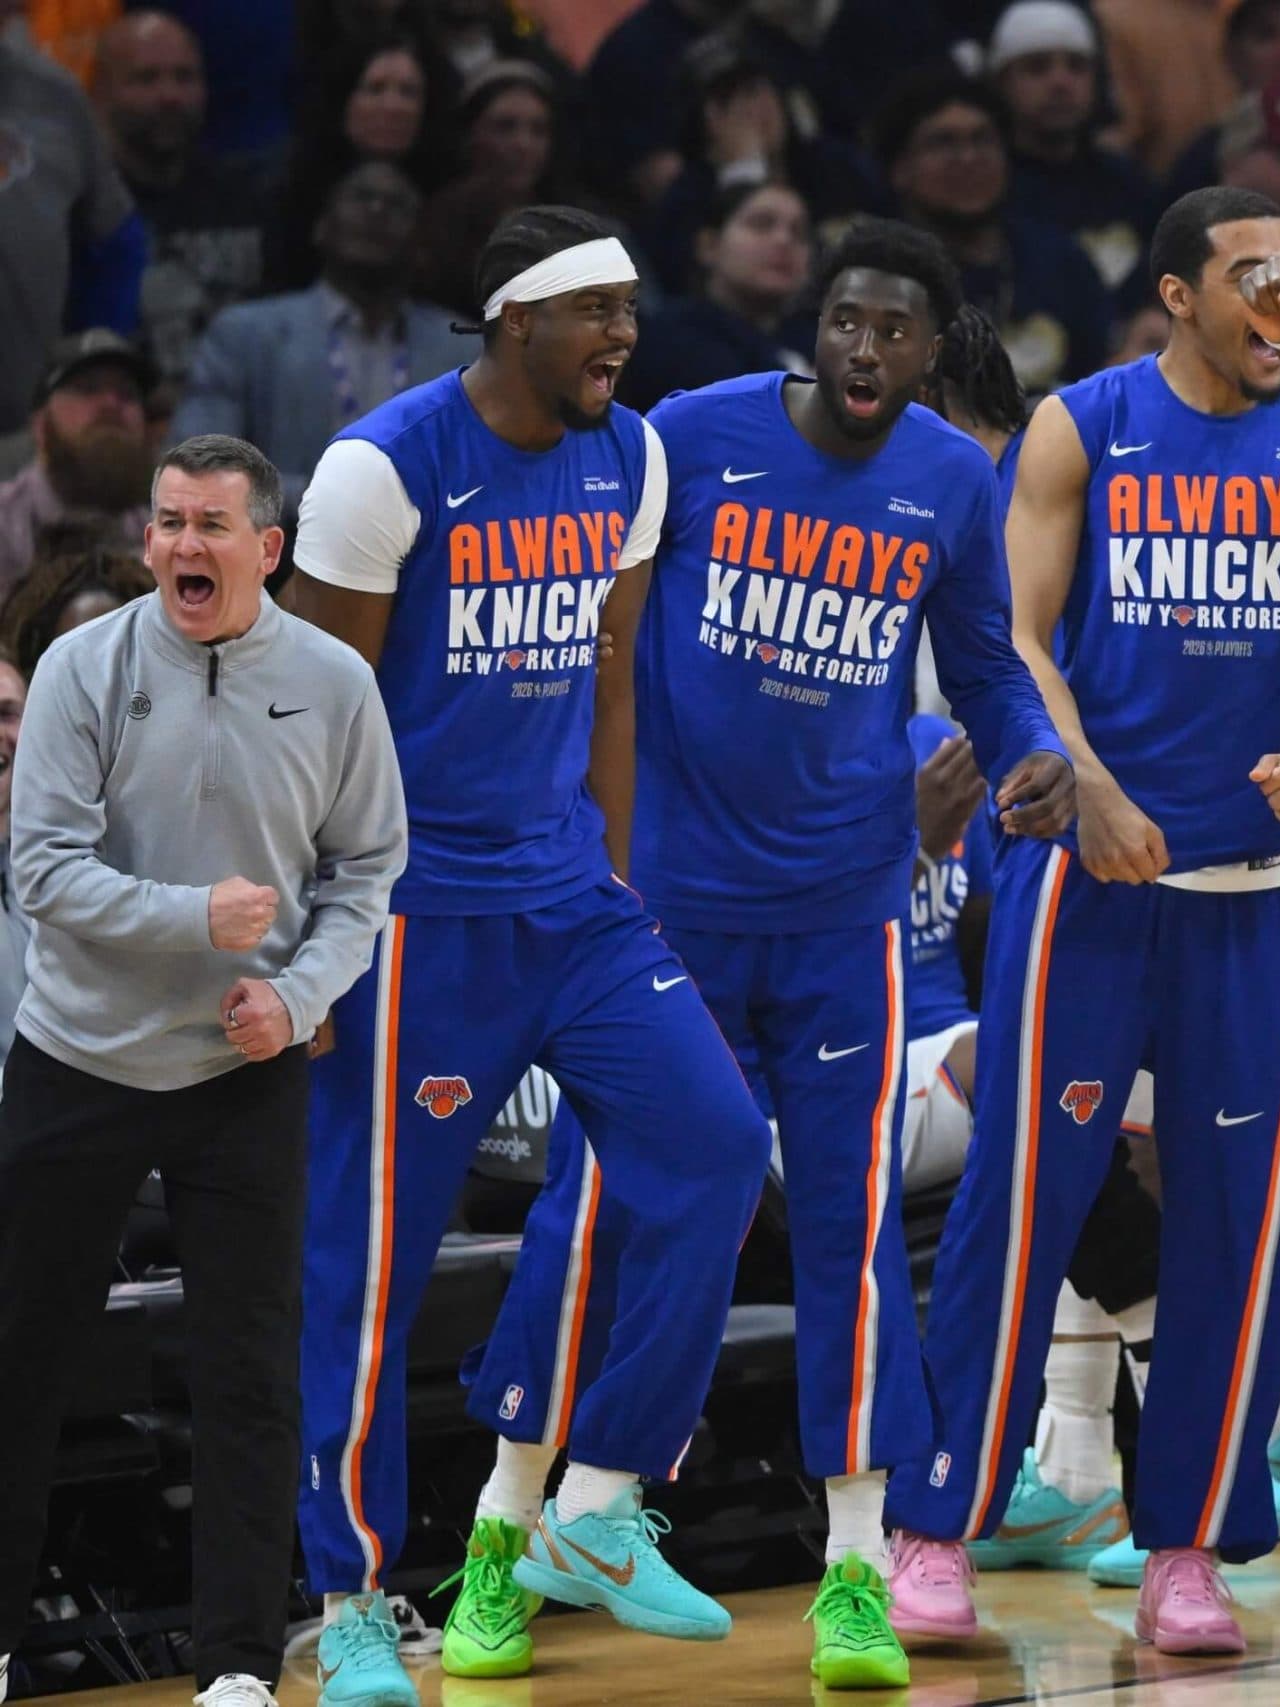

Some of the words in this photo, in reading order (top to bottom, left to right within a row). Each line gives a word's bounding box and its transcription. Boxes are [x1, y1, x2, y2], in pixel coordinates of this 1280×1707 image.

[888, 502, 906, 514] abu
[906, 506, 935, 519] dhabi
[449, 511, 625, 584] ALWAYS
[710, 502, 930, 600] ALWAYS
[448, 577, 616, 648] KNICK
[702, 561, 910, 660] KNICKS
[1112, 601, 1151, 626] NEW
[1159, 604, 1226, 629] YRK
[447, 651, 493, 675] NEW
[699, 620, 739, 657] NEW
[744, 639, 808, 676] YRK
[813, 657, 889, 687] FOREVER
[1181, 639, 1206, 656] 2026
[1214, 641, 1253, 657] PLAYOFFS
[512, 681, 534, 698] 2026
[759, 676, 784, 697] 2026
[789, 686, 831, 708] PLAYOFFS
